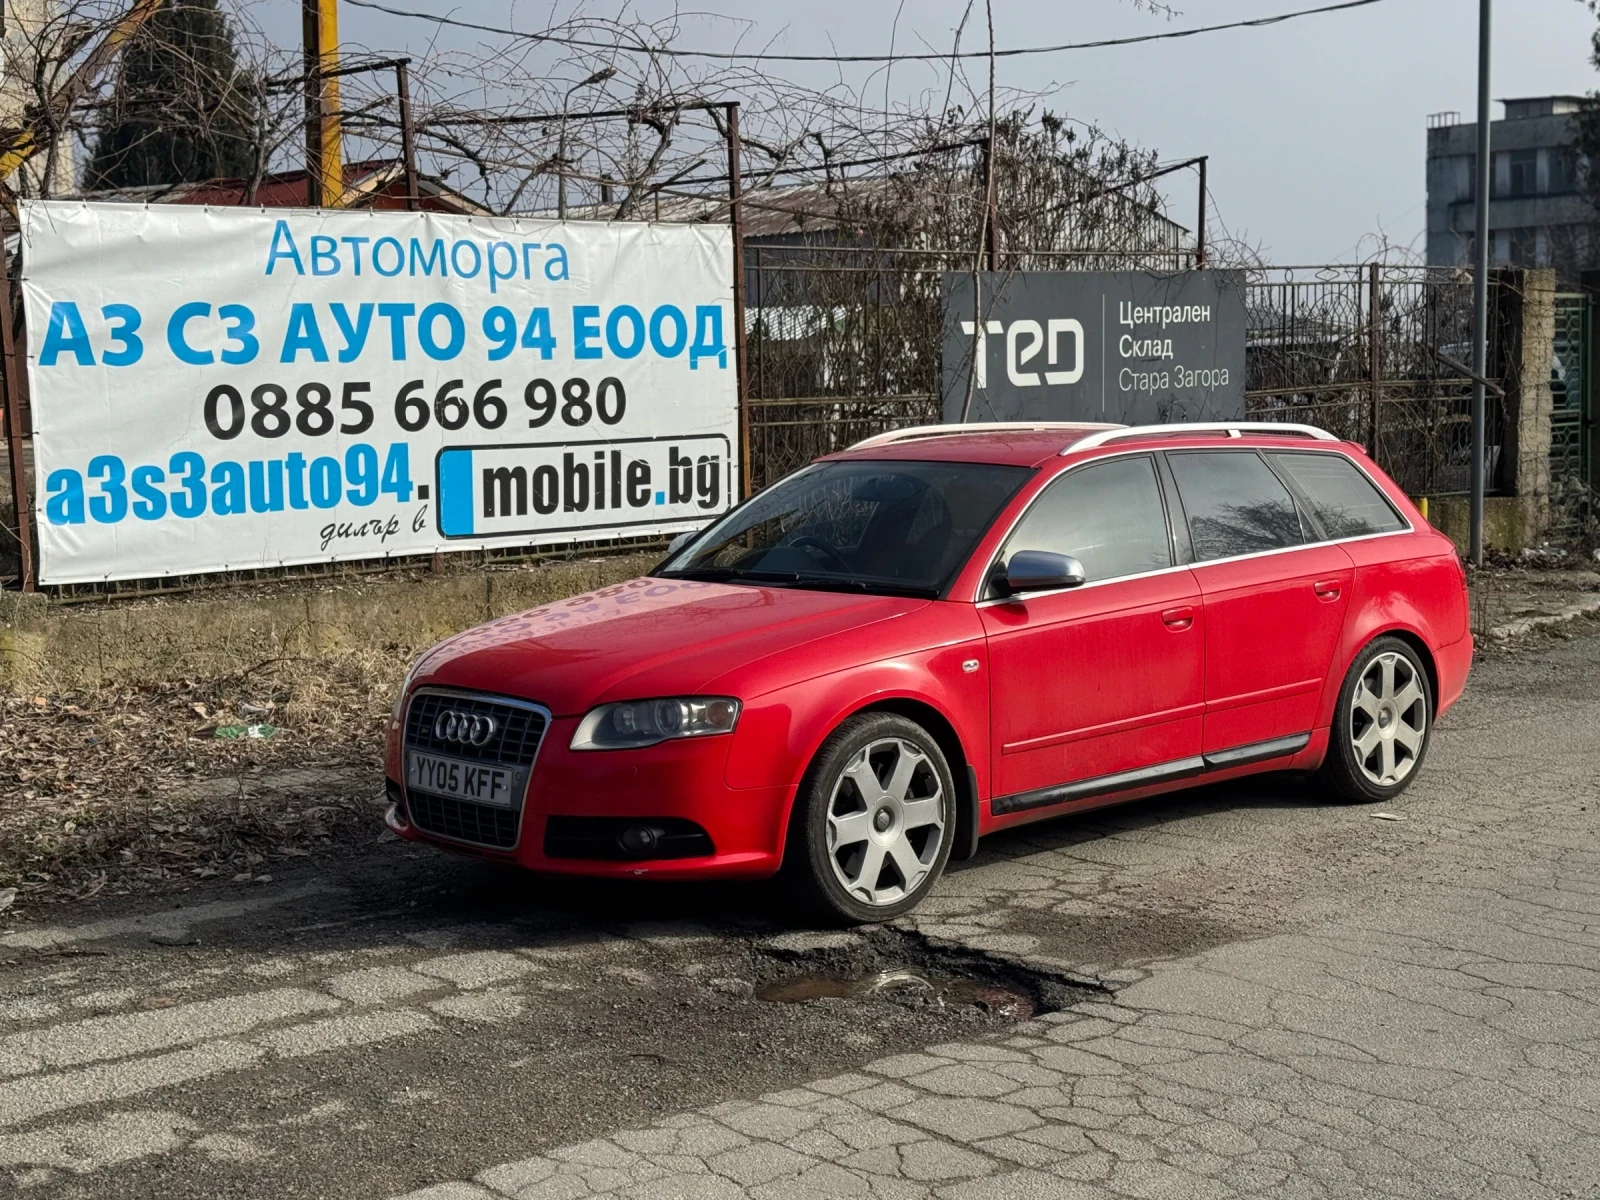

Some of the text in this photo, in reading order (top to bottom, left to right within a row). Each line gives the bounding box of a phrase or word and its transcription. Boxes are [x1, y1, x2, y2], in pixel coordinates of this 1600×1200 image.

[265, 219, 569, 294] Автоморга
[280, 302, 466, 364] АУТО
[482, 305, 557, 362] 94
[572, 304, 728, 370] ЕООД
[1119, 301, 1210, 329] Централен
[1119, 334, 1173, 360] Склад
[1119, 365, 1229, 395] Стара Загора
[203, 376, 626, 440] 0885 666 980
[482, 446, 720, 518] mobile.bg
[319, 516, 399, 551] дилър
[416, 756, 505, 800] YY05 KFF
